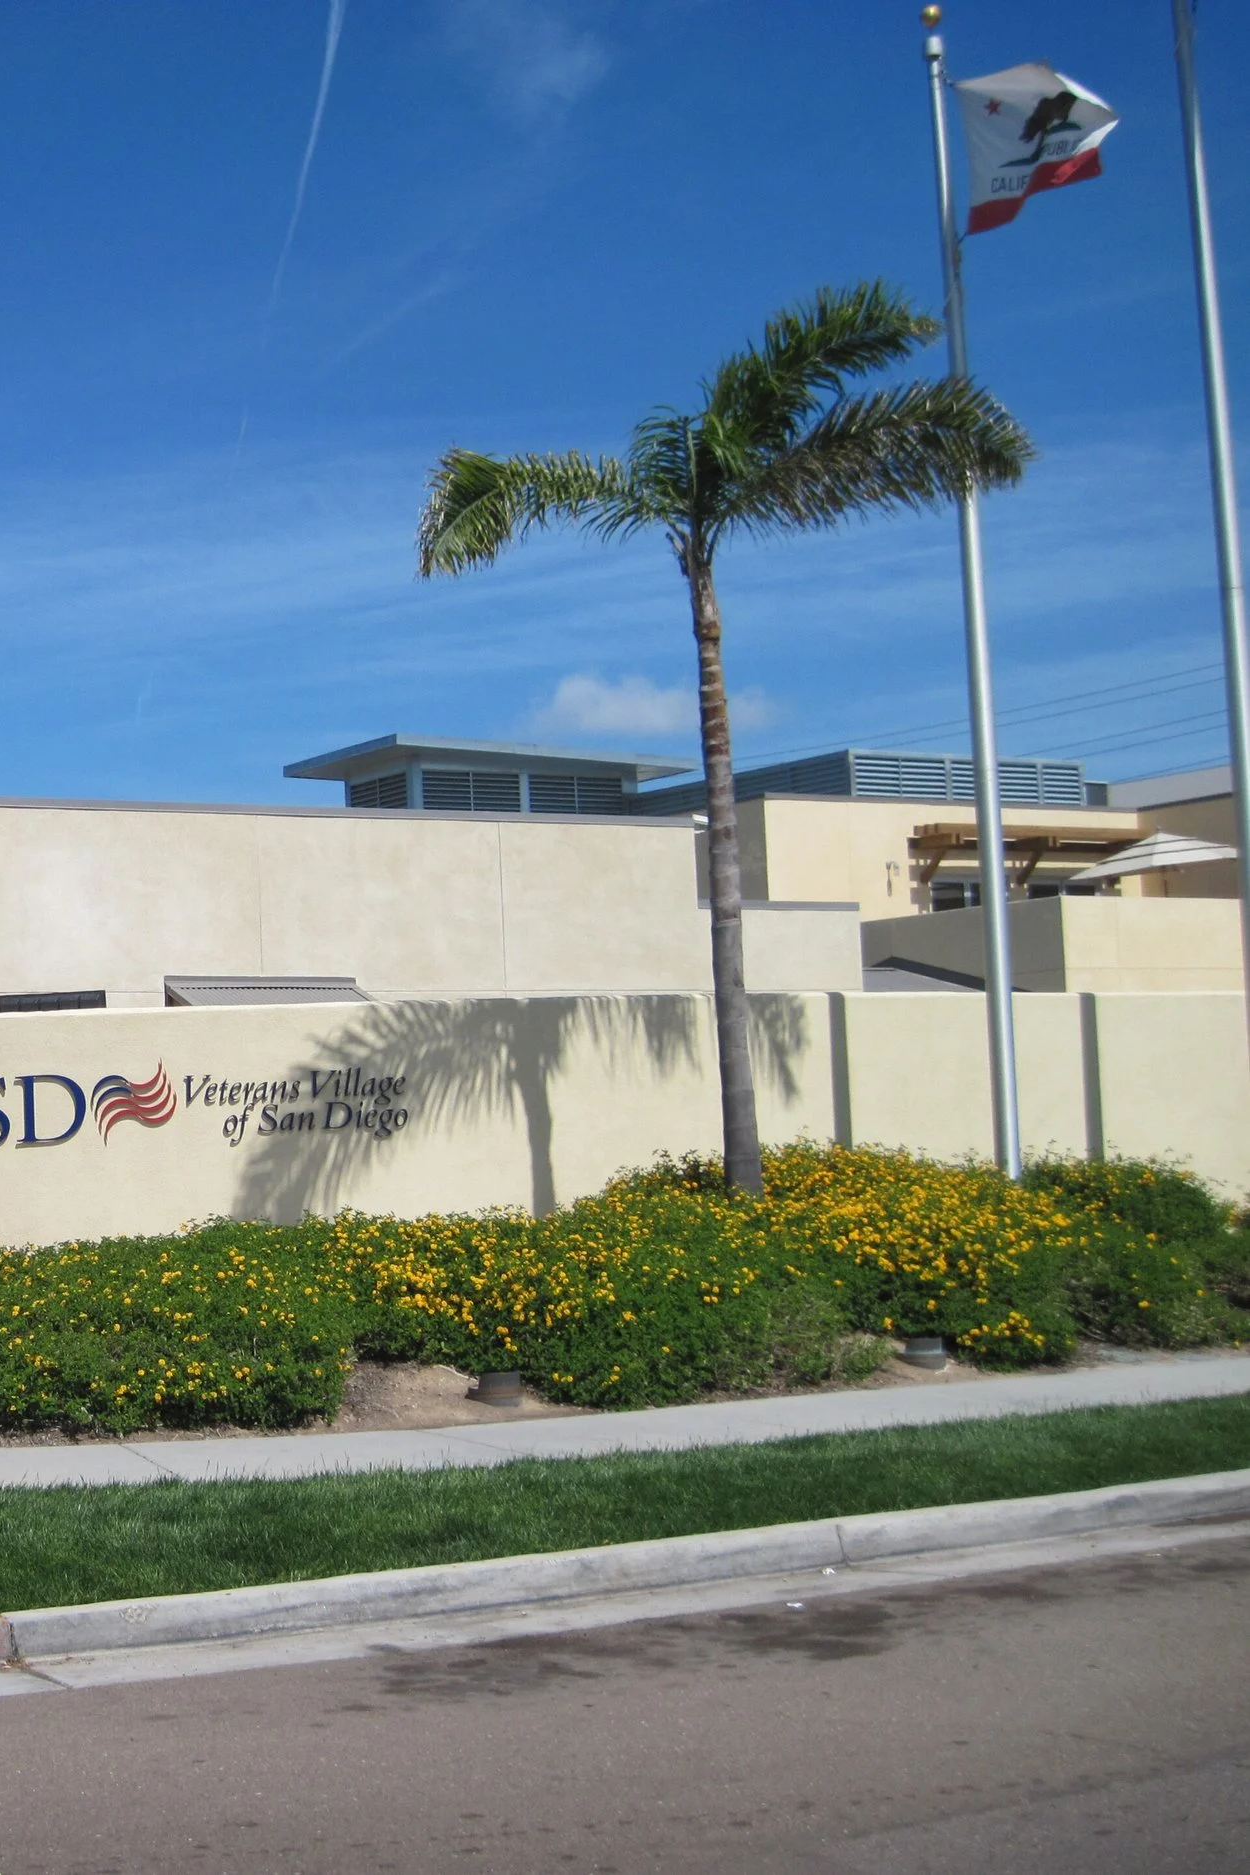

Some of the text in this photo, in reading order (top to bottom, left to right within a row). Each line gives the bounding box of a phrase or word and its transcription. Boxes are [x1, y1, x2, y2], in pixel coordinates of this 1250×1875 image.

[183, 1067, 407, 1107] Veterans Village
[223, 1099, 409, 1146] of San Diego
